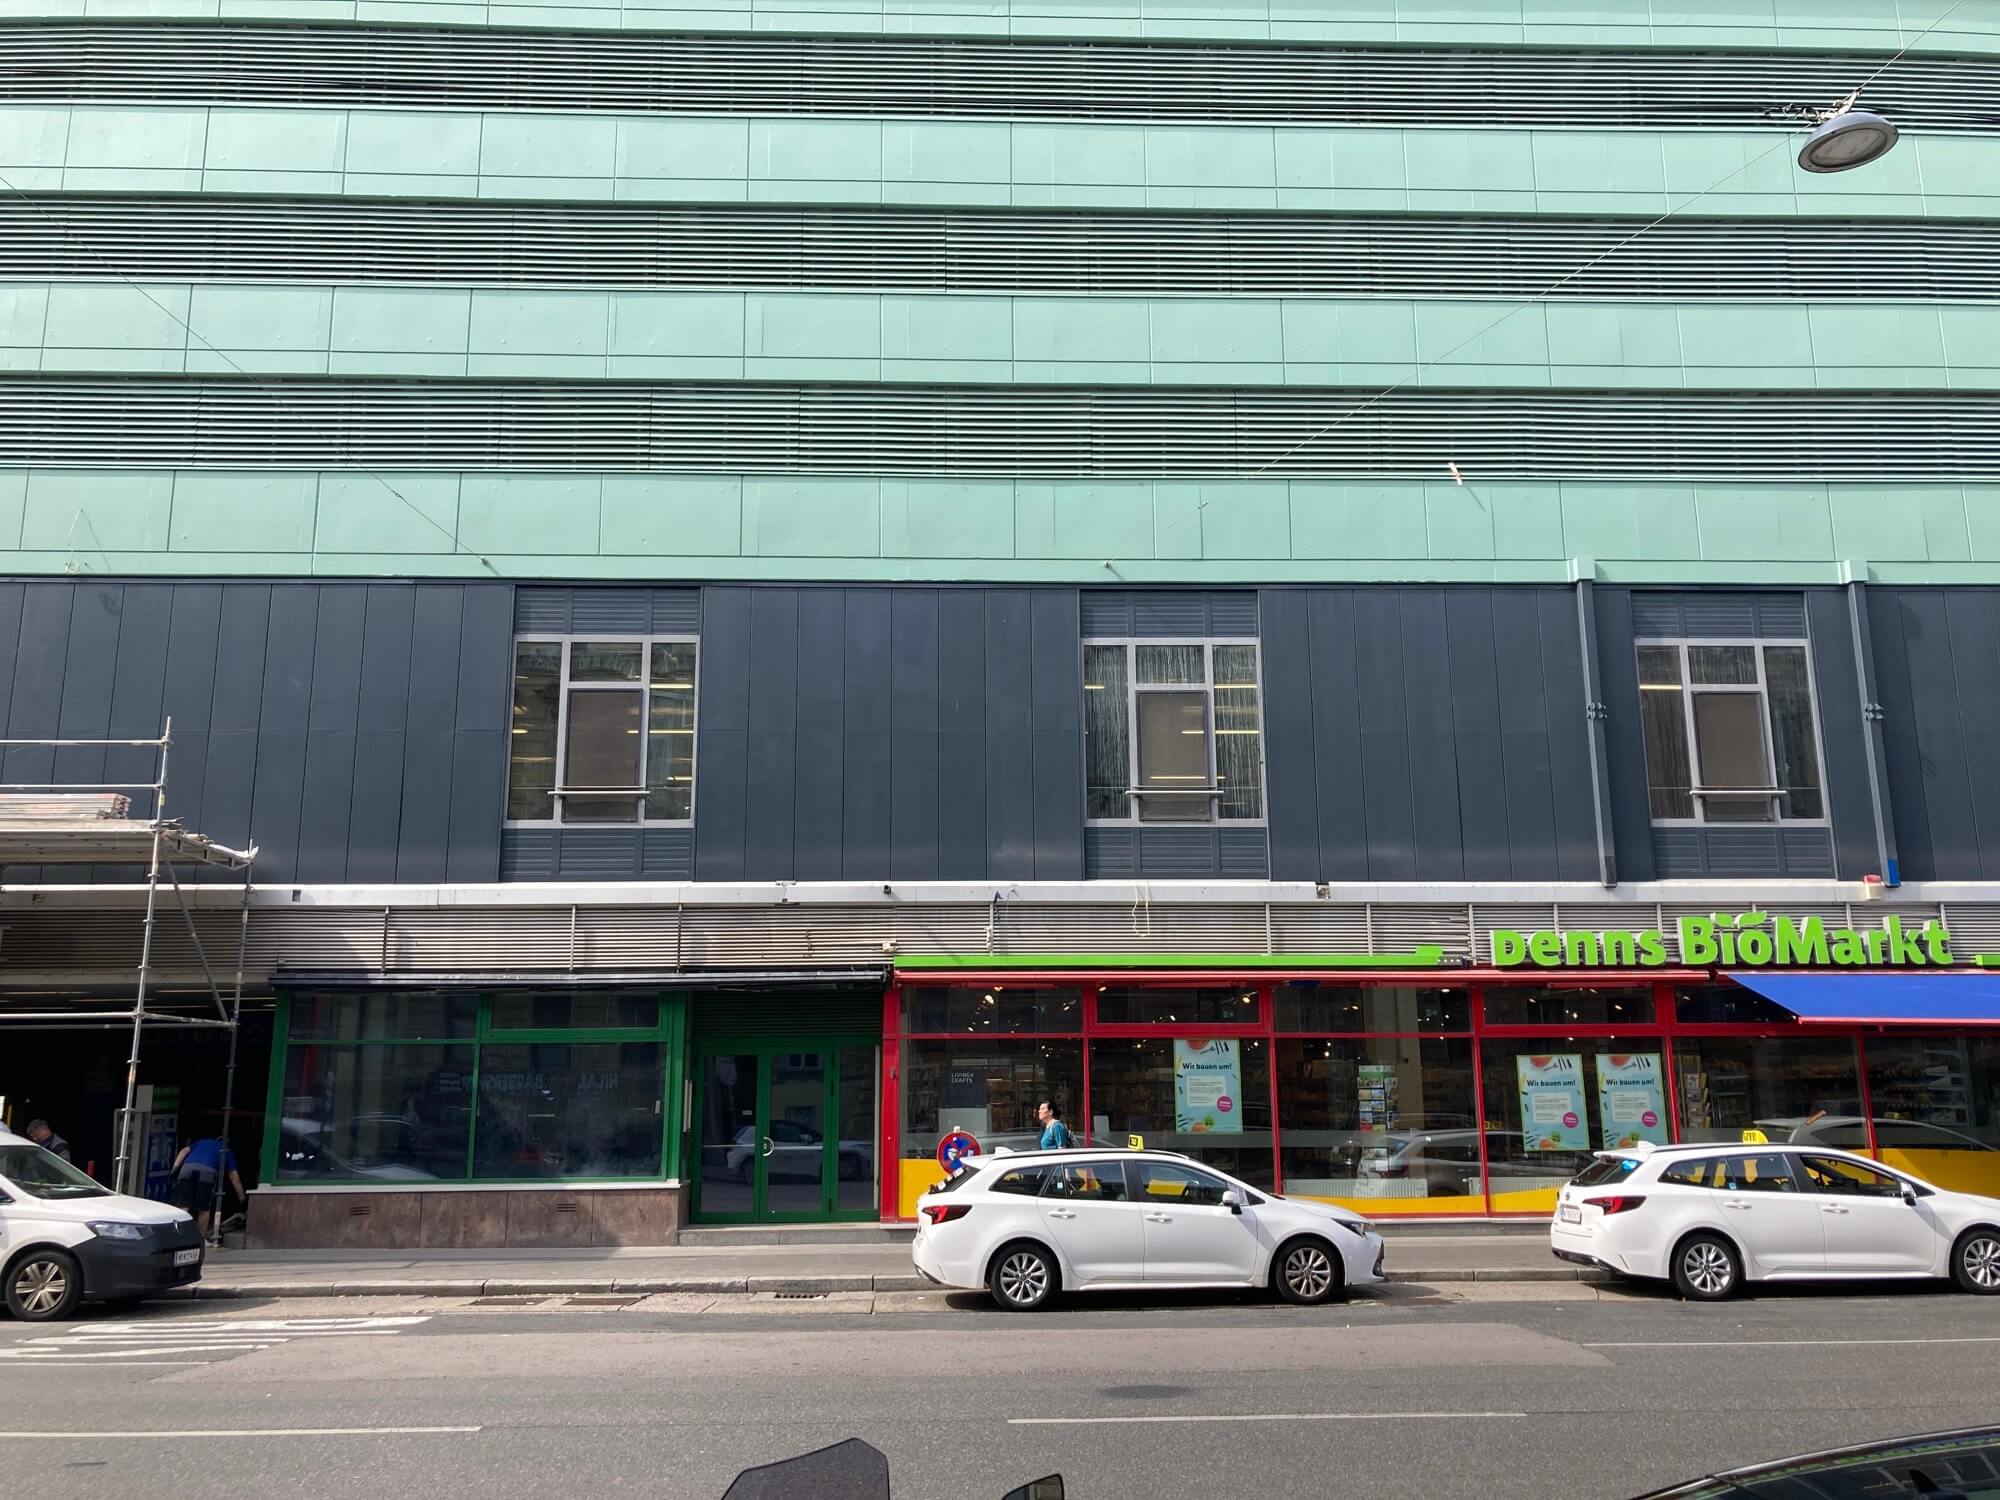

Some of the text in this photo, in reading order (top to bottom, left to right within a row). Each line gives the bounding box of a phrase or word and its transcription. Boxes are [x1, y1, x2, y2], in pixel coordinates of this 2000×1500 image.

[1490, 911, 1954, 967] Denns BioMarkt
[1182, 1062, 1232, 1070] Wir bauen um!
[1527, 1079, 1576, 1087] Wir bauen um!
[1606, 1077, 1655, 1086] Wir bauen um!
